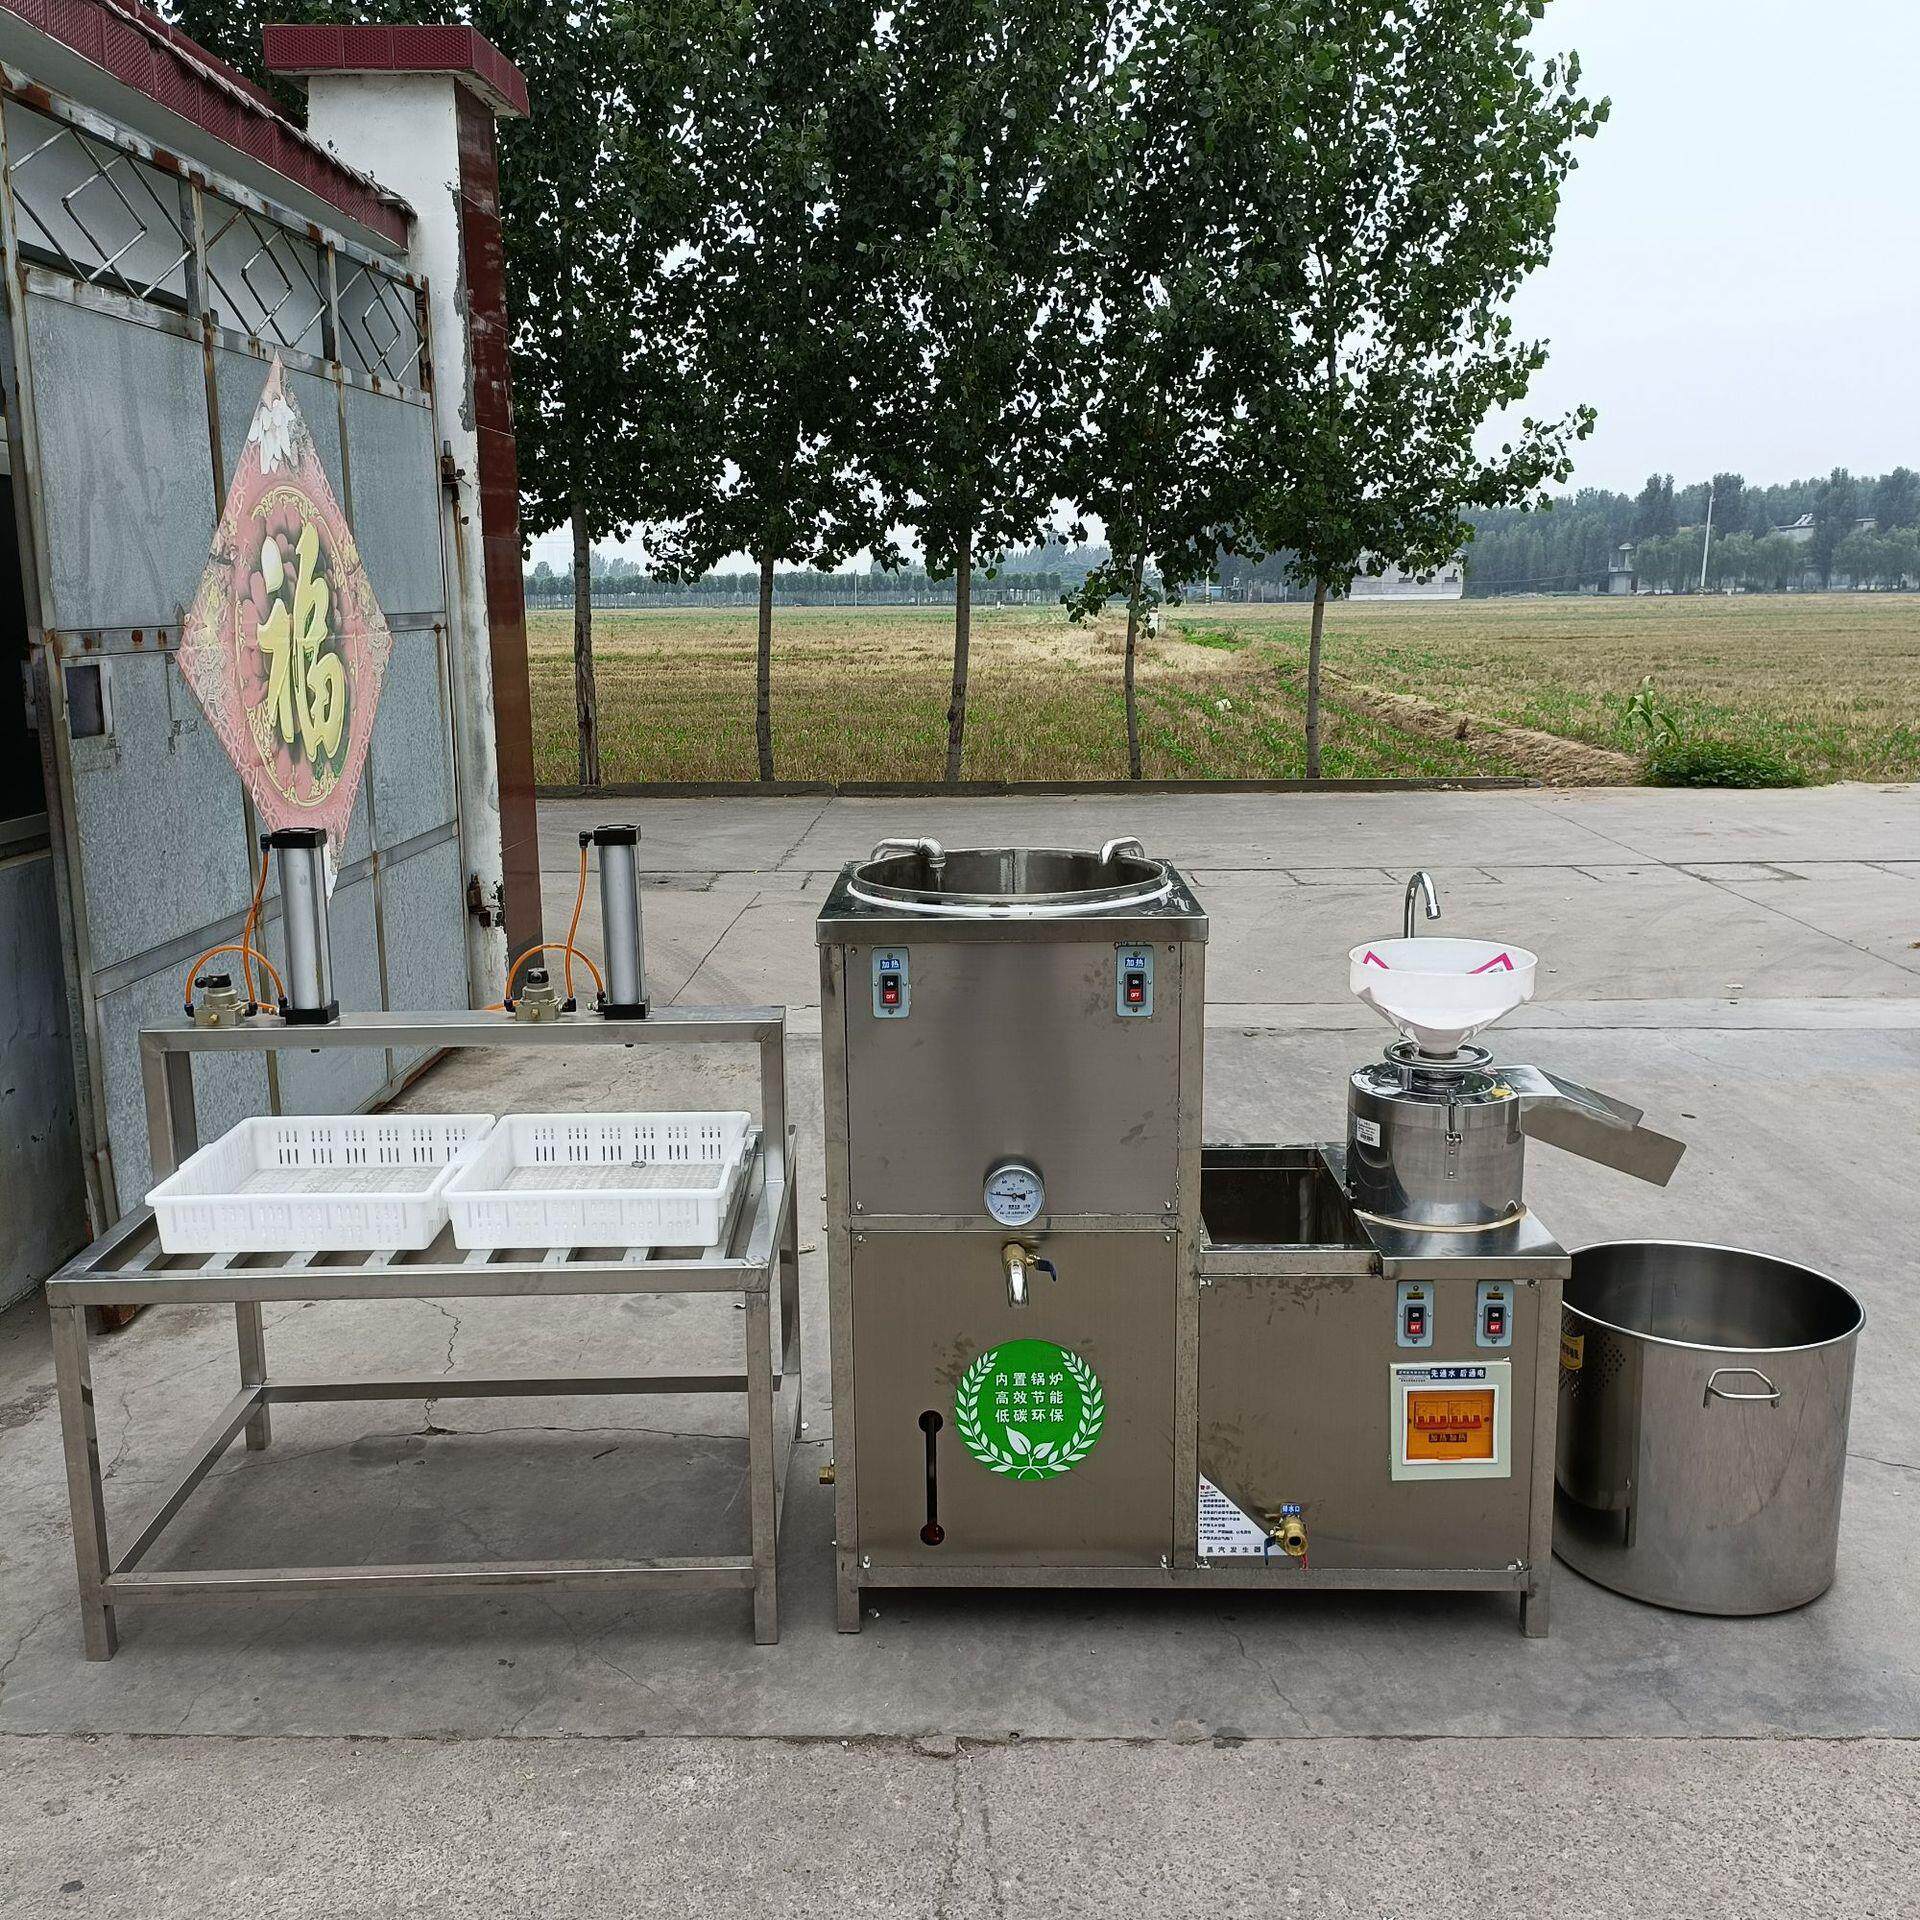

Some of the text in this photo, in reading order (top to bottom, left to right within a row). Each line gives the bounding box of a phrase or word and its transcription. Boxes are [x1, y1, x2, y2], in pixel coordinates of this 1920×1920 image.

[257, 520, 347, 763] 福
[881, 960, 900, 969] 加热
[1125, 957, 1144, 967] 加热
[995, 1372, 1064, 1387] 内置锅炉
[1430, 1368, 1456, 1378] 先通水
[1459, 1368, 1485, 1378] 后通电
[995, 1390, 1064, 1405] 高效节能
[995, 1408, 1064, 1423] 低碳环保
